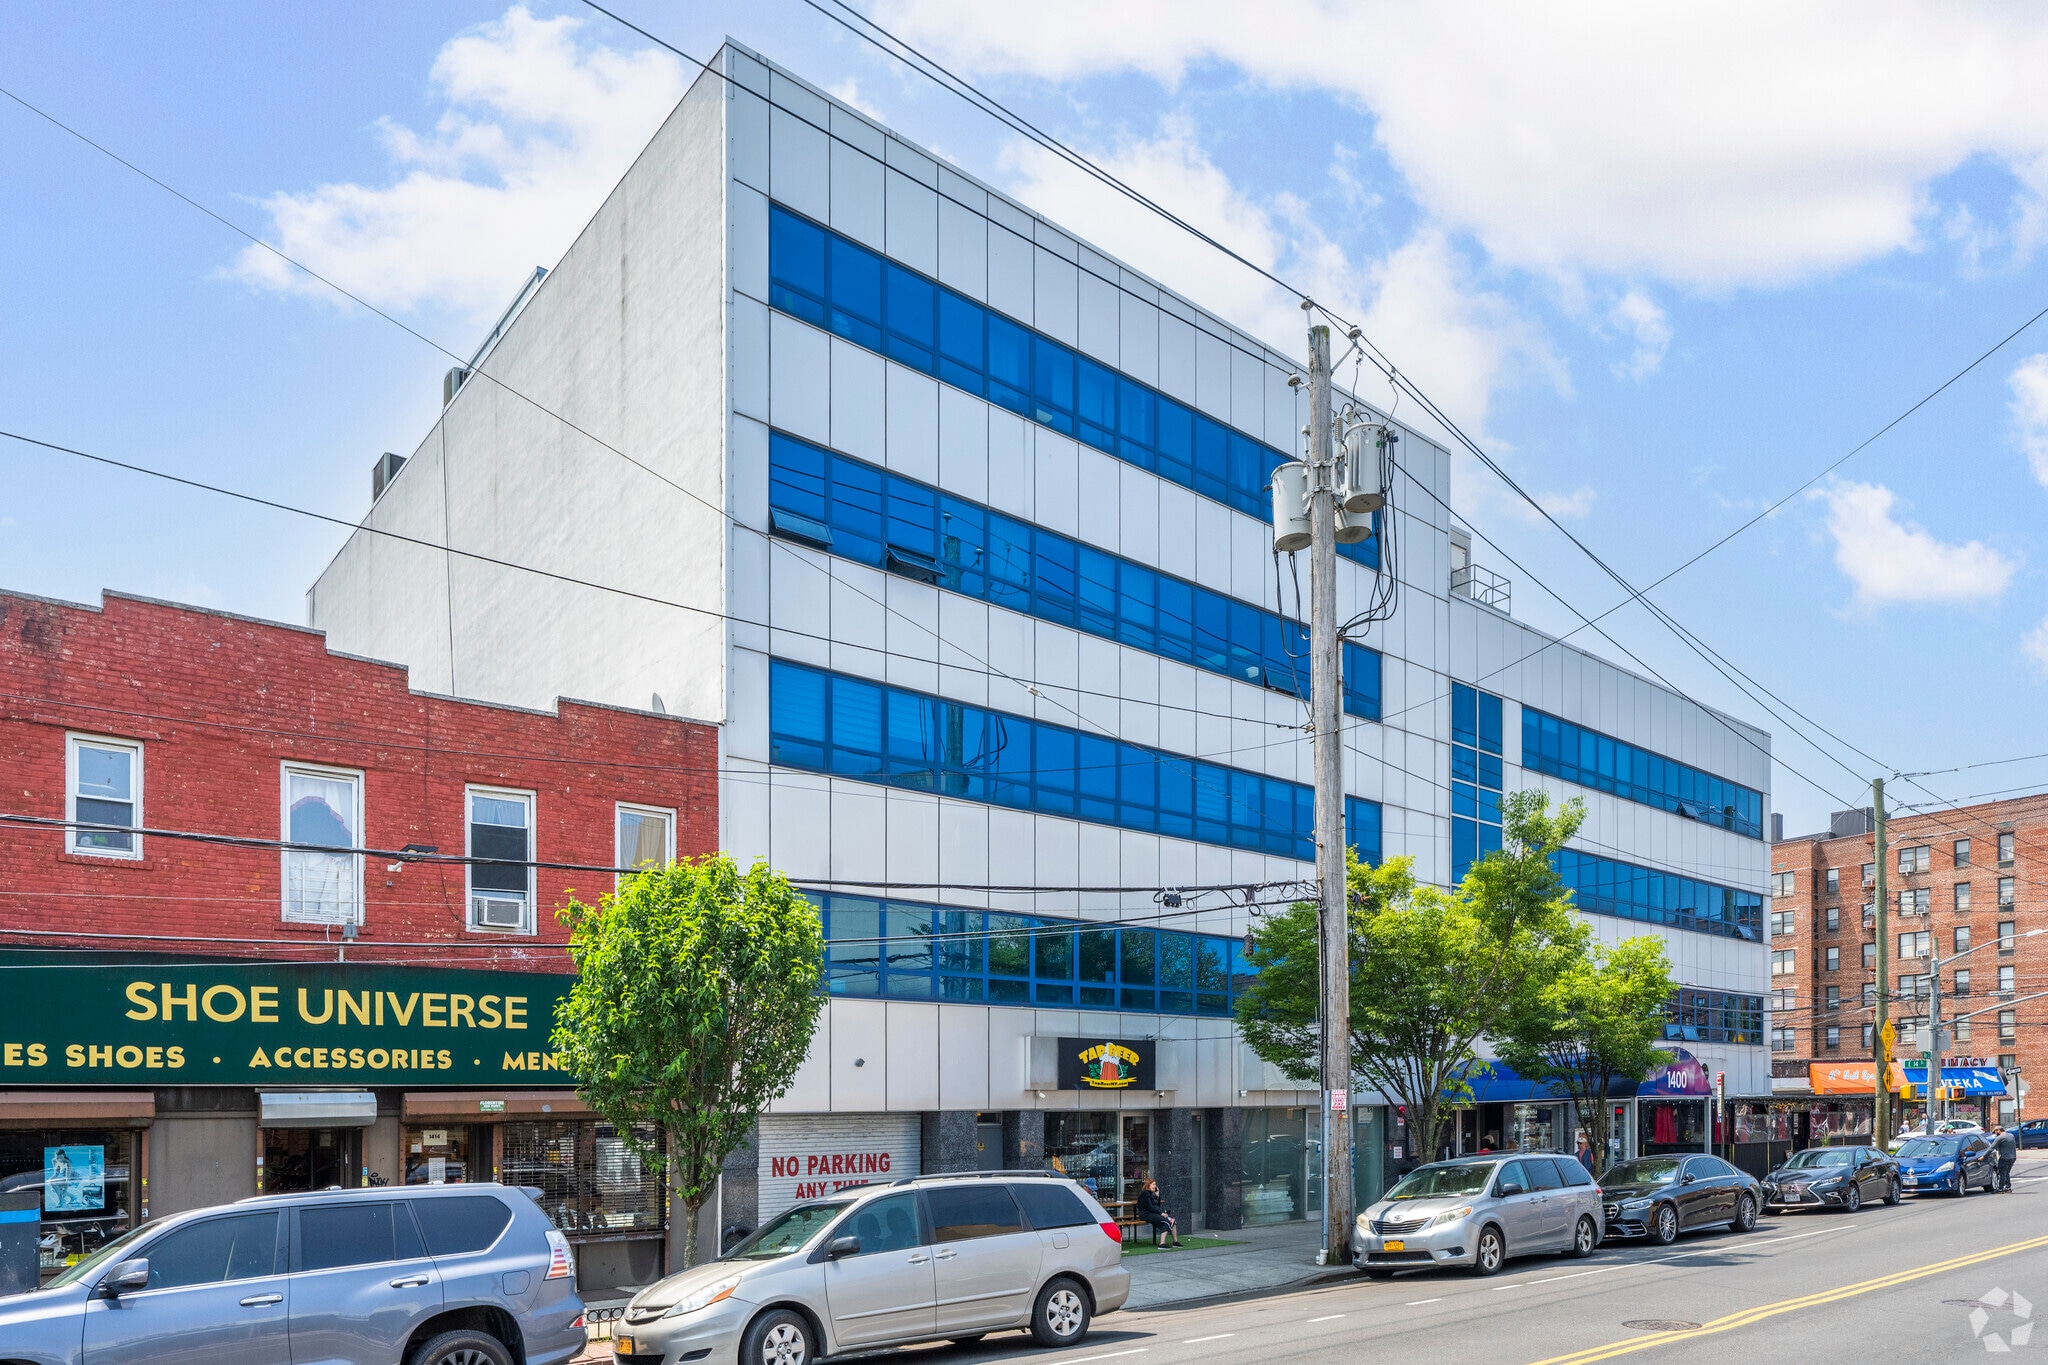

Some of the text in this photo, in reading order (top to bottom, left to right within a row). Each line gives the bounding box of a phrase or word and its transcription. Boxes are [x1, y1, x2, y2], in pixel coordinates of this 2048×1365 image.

[125, 981, 528, 1029] SHOE UNIVERSE
[65, 1043, 185, 1069] SHOES
[248, 1046, 452, 1070] ACCESSORIES
[1078, 1043, 1140, 1066] TAP BEER
[1941, 1058, 1988, 1067] RMACY
[1667, 1071, 1687, 1088] 1400
[771, 1153, 891, 1178] NO PARKING
[795, 1182, 828, 1199] ANY
